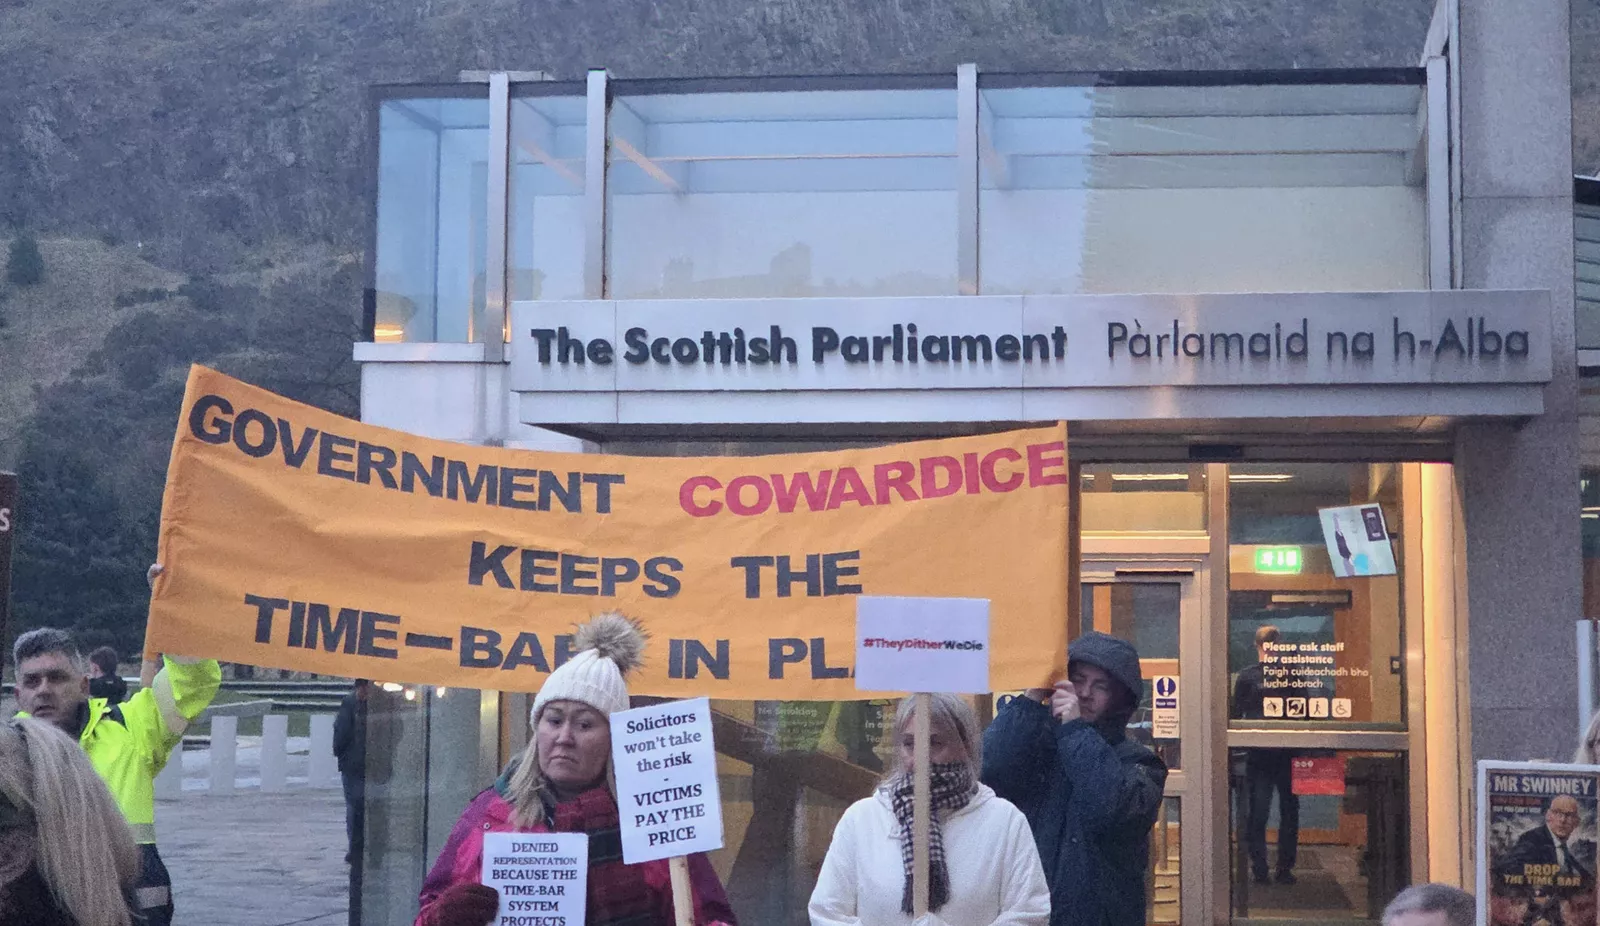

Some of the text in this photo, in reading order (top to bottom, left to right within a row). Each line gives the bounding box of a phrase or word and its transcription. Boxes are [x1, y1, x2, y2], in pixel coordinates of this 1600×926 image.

[531, 323, 1067, 364] The Scottish Parliament
[1107, 316, 1529, 358] Pàrlamaid na h-Alba
[188, 394, 1068, 518] GOVERNMENT COWARDICE
[468, 541, 862, 599] KEEPS THE
[863, 638, 983, 652] #TheyDitherWeDie
[1262, 642, 1345, 652] Please ask staff
[668, 638, 730, 680] IN
[768, 637, 856, 680] PL
[1262, 653, 1334, 664] for assistance
[1263, 666, 1369, 677] Faigh cuideachadh bho
[1263, 679, 1323, 688] luchd-obrach
[626, 712, 696, 734] Solicitors
[624, 731, 702, 754] won't take
[636, 752, 692, 772] the risk
[1494, 775, 1591, 795] MR SWINNEY
[633, 784, 702, 807] VICTIMS
[635, 803, 705, 827] PAY THE
[648, 825, 696, 847] PRICE
[511, 842, 559, 853] DENIED
[493, 857, 577, 866] REPRESENTATION
[492, 869, 577, 880] BECAUSE THE
[1524, 863, 1560, 876] DROP
[1504, 874, 1581, 887] THE TIME BAR
[503, 885, 565, 896] TIME-BAR
[508, 900, 559, 911] SYSTEM
[501, 916, 566, 926] PROTECTS
